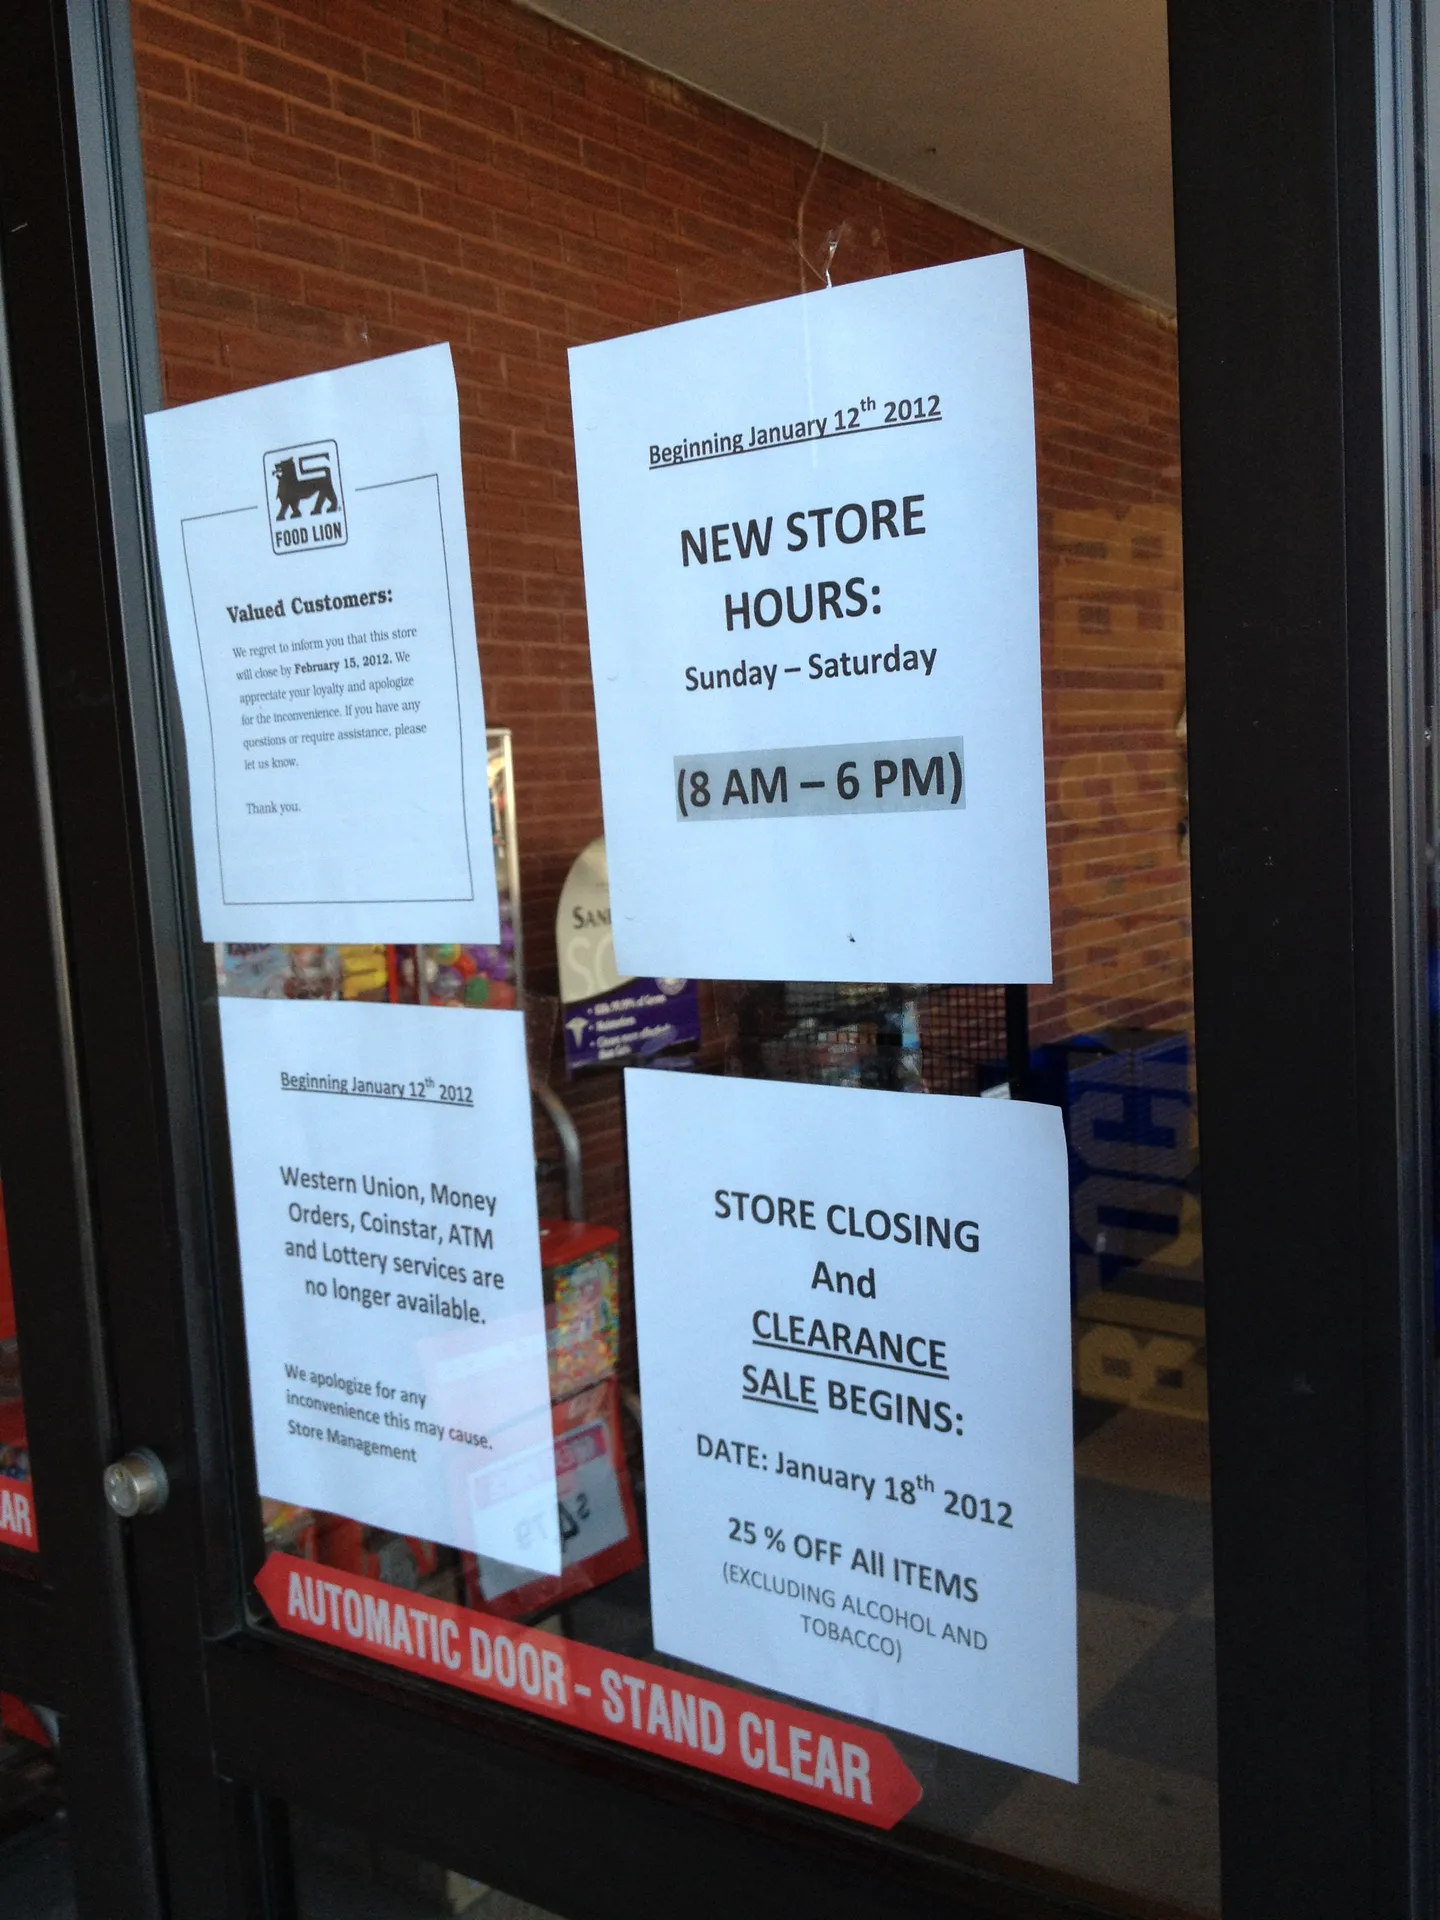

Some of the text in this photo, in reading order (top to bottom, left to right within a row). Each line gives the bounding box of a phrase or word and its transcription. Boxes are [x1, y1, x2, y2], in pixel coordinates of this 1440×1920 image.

[649, 395, 941, 466] Beginning January 12th 2012
[275, 521, 342, 548] FOOD LION
[681, 494, 926, 567] NEW STORE
[226, 589, 393, 623] Valued Customers:
[725, 577, 881, 631] HOURS:
[232, 628, 417, 658] We regret to inform you that this store
[236, 651, 410, 680] will close by February 15, 2012. We
[685, 660, 777, 691] Sunday
[809, 643, 937, 679] Saturday
[240, 676, 414, 705] appreciate your loyalty and apologize
[242, 701, 420, 725] for the inconvenience. If you have any
[243, 723, 426, 751] questions or require assistance, please
[244, 758, 298, 770] let us know.
[677, 768, 711, 818] (8
[722, 766, 788, 806] AM
[837, 761, 860, 800] 6
[874, 751, 962, 804] PM)
[246, 801, 301, 815] Thank you.
[280, 1072, 473, 1101] Beginning January 12th 2012
[280, 1166, 496, 1217] Western Union, Money
[289, 1202, 493, 1250] Orders, Coinstar, ATM
[715, 1189, 979, 1253] STORE CLOSING
[285, 1239, 504, 1290] and Lottery services are
[811, 1260, 876, 1299] And
[305, 1278, 486, 1324] no longer available.
[752, 1309, 950, 1381] CLEARANCE
[285, 1364, 426, 1409] We apologize for any
[742, 1364, 963, 1437] SALE BEGINS:
[287, 1389, 492, 1450] inconvenience this may cause.
[288, 1420, 416, 1462] Store Management
[697, 1433, 1014, 1529] DATE: January 18th 2012
[0, 1489, 32, 1538] AR
[728, 1517, 979, 1604] 25 % OFF All ITEMS
[723, 1561, 988, 1650] (EXCLUDING ALCOHOL AND
[800, 1614, 902, 1663] TOBACCO)
[288, 1571, 461, 1670] AUTOMATIC
[470, 1627, 568, 1705] DOOR
[600, 1669, 726, 1755] STAND
[739, 1712, 872, 1804] CLEAR
